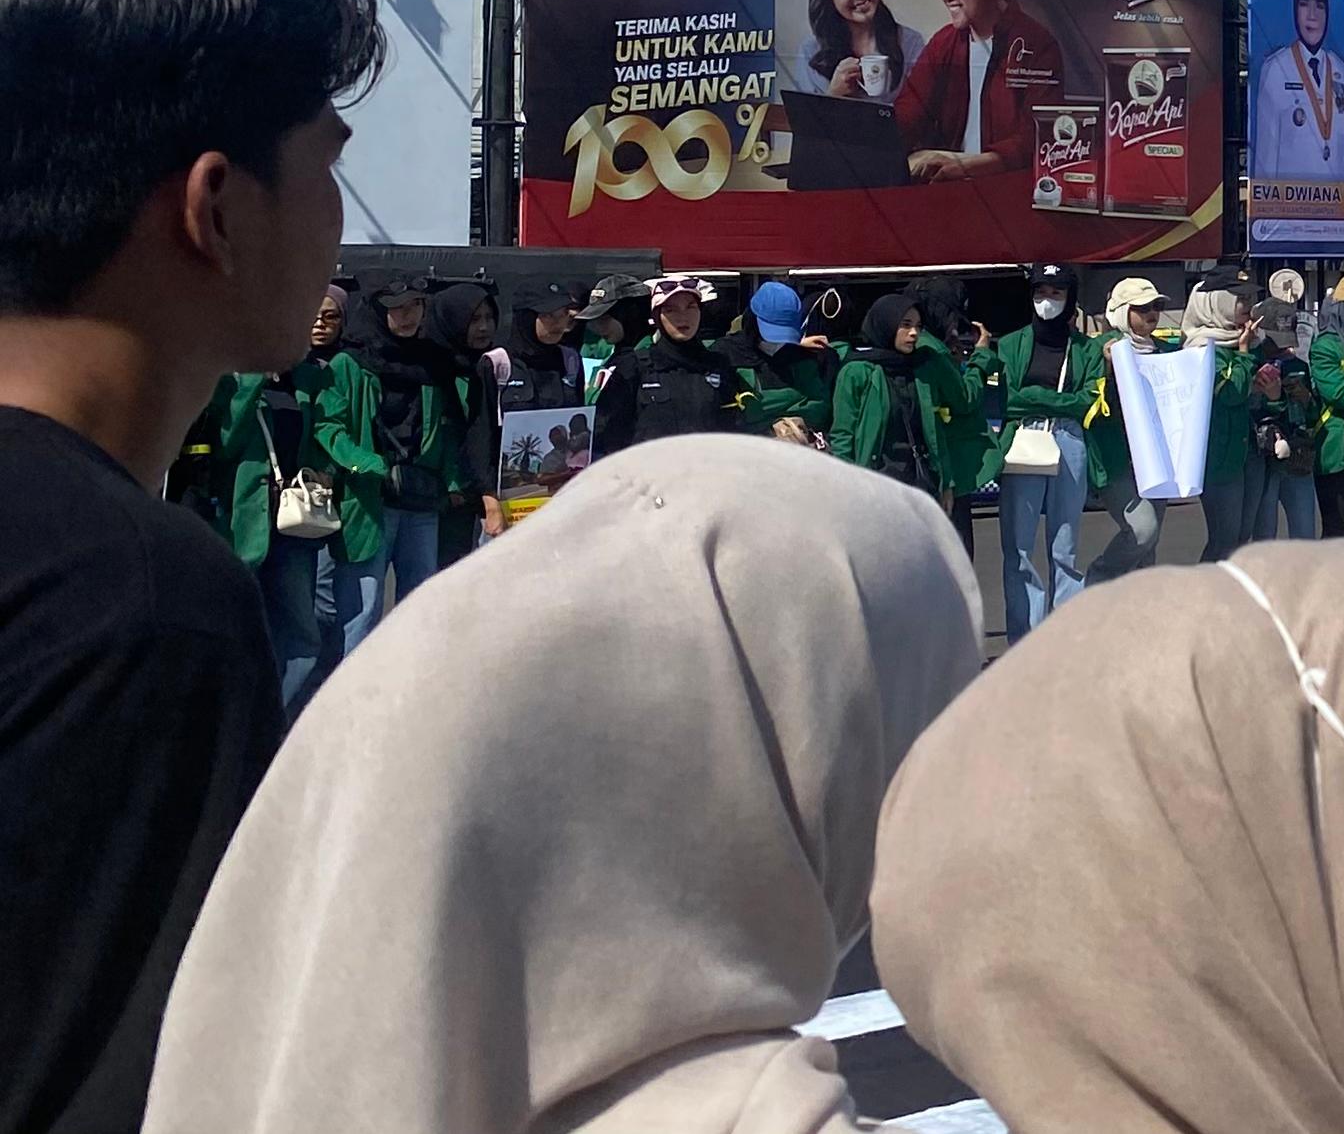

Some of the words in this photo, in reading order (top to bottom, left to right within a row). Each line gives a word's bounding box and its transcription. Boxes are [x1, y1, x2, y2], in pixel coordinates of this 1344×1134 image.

[615, 17, 680, 37] TERIMA
[685, 13, 736, 31] KASIH
[615, 36, 698, 62] UNTUK
[704, 30, 773, 55] KAMU
[614, 64, 661, 83] YANG
[666, 58, 729, 78] SELALU
[609, 71, 776, 114] SEMANGAT
[1108, 101, 1153, 140] Kapal
[1154, 96, 1184, 127] Api
[563, 103, 771, 219] 100%
[1147, 145, 1180, 155] SPECIAL
[1253, 185, 1280, 201] EVA
[1285, 186, 1342, 203] DWIANA
